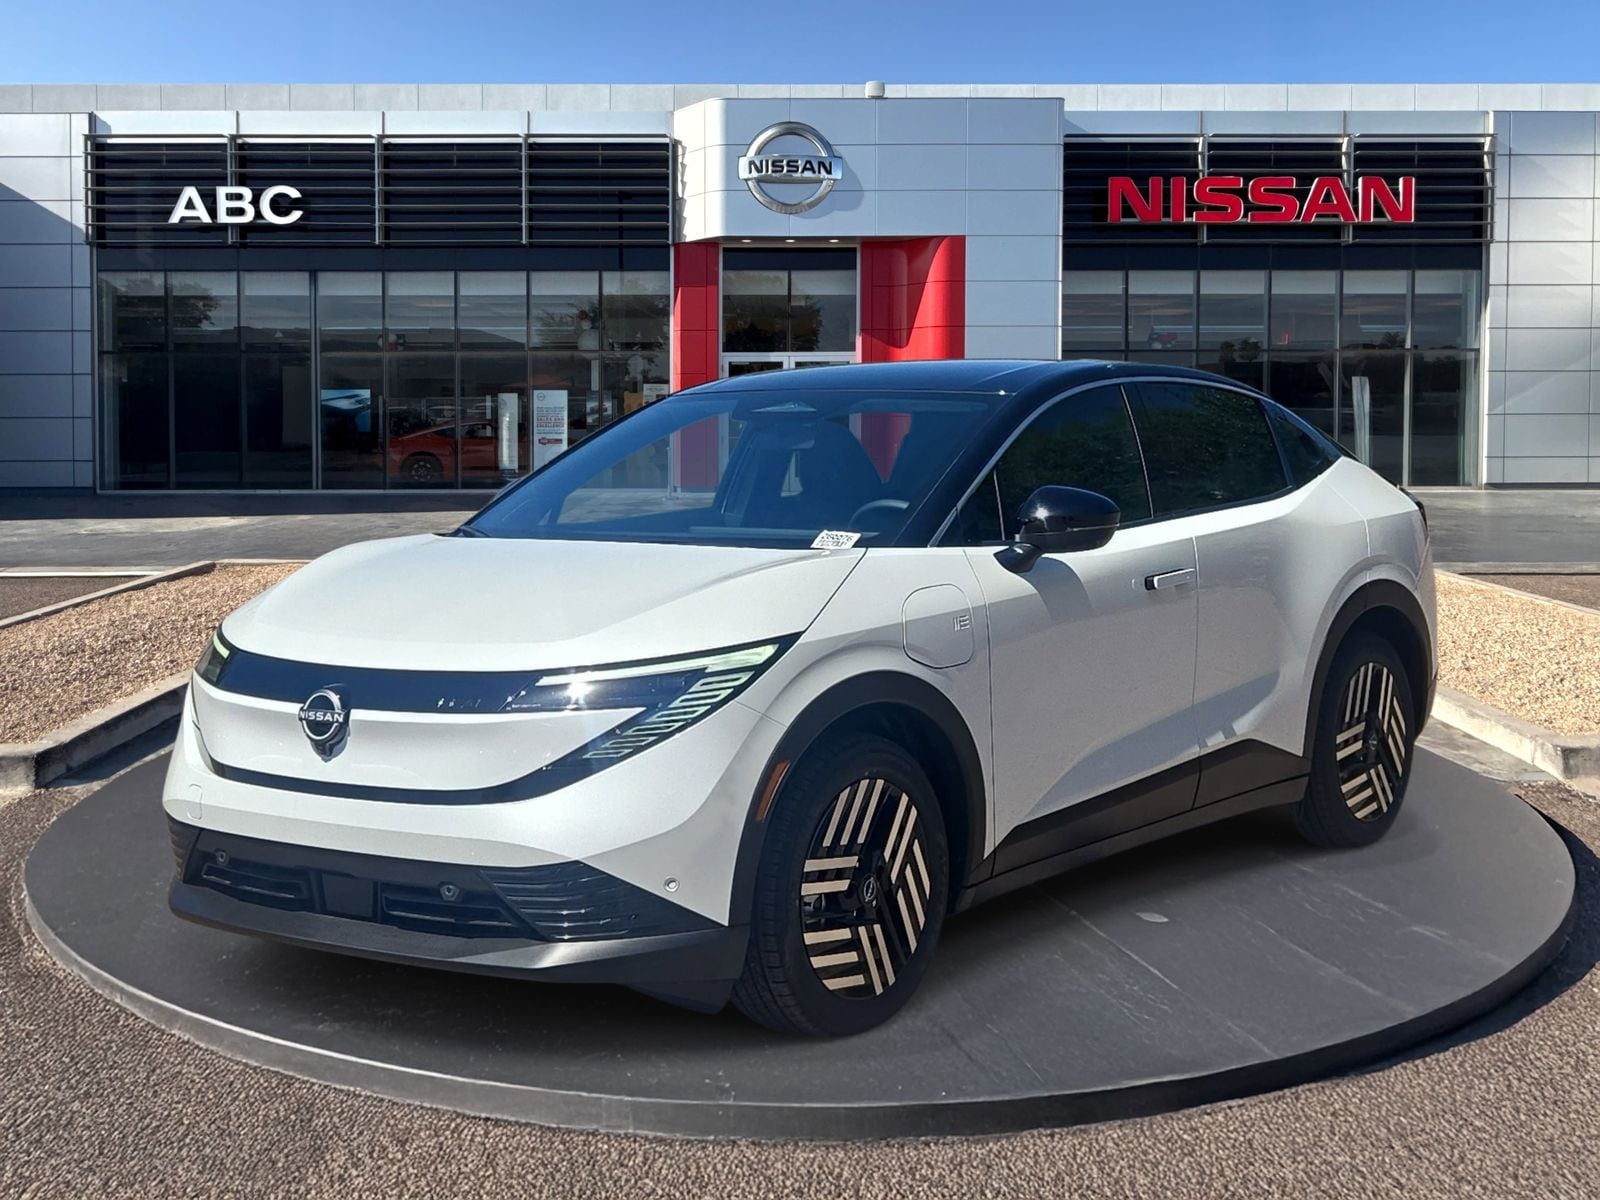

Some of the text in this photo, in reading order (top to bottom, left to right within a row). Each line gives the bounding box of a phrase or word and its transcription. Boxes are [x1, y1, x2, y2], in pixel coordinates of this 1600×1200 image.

[748, 159, 833, 175] NISSAN
[167, 185, 304, 225] ABC
[1107, 176, 1416, 223] NISSAN
[300, 711, 344, 722] NISSAN
